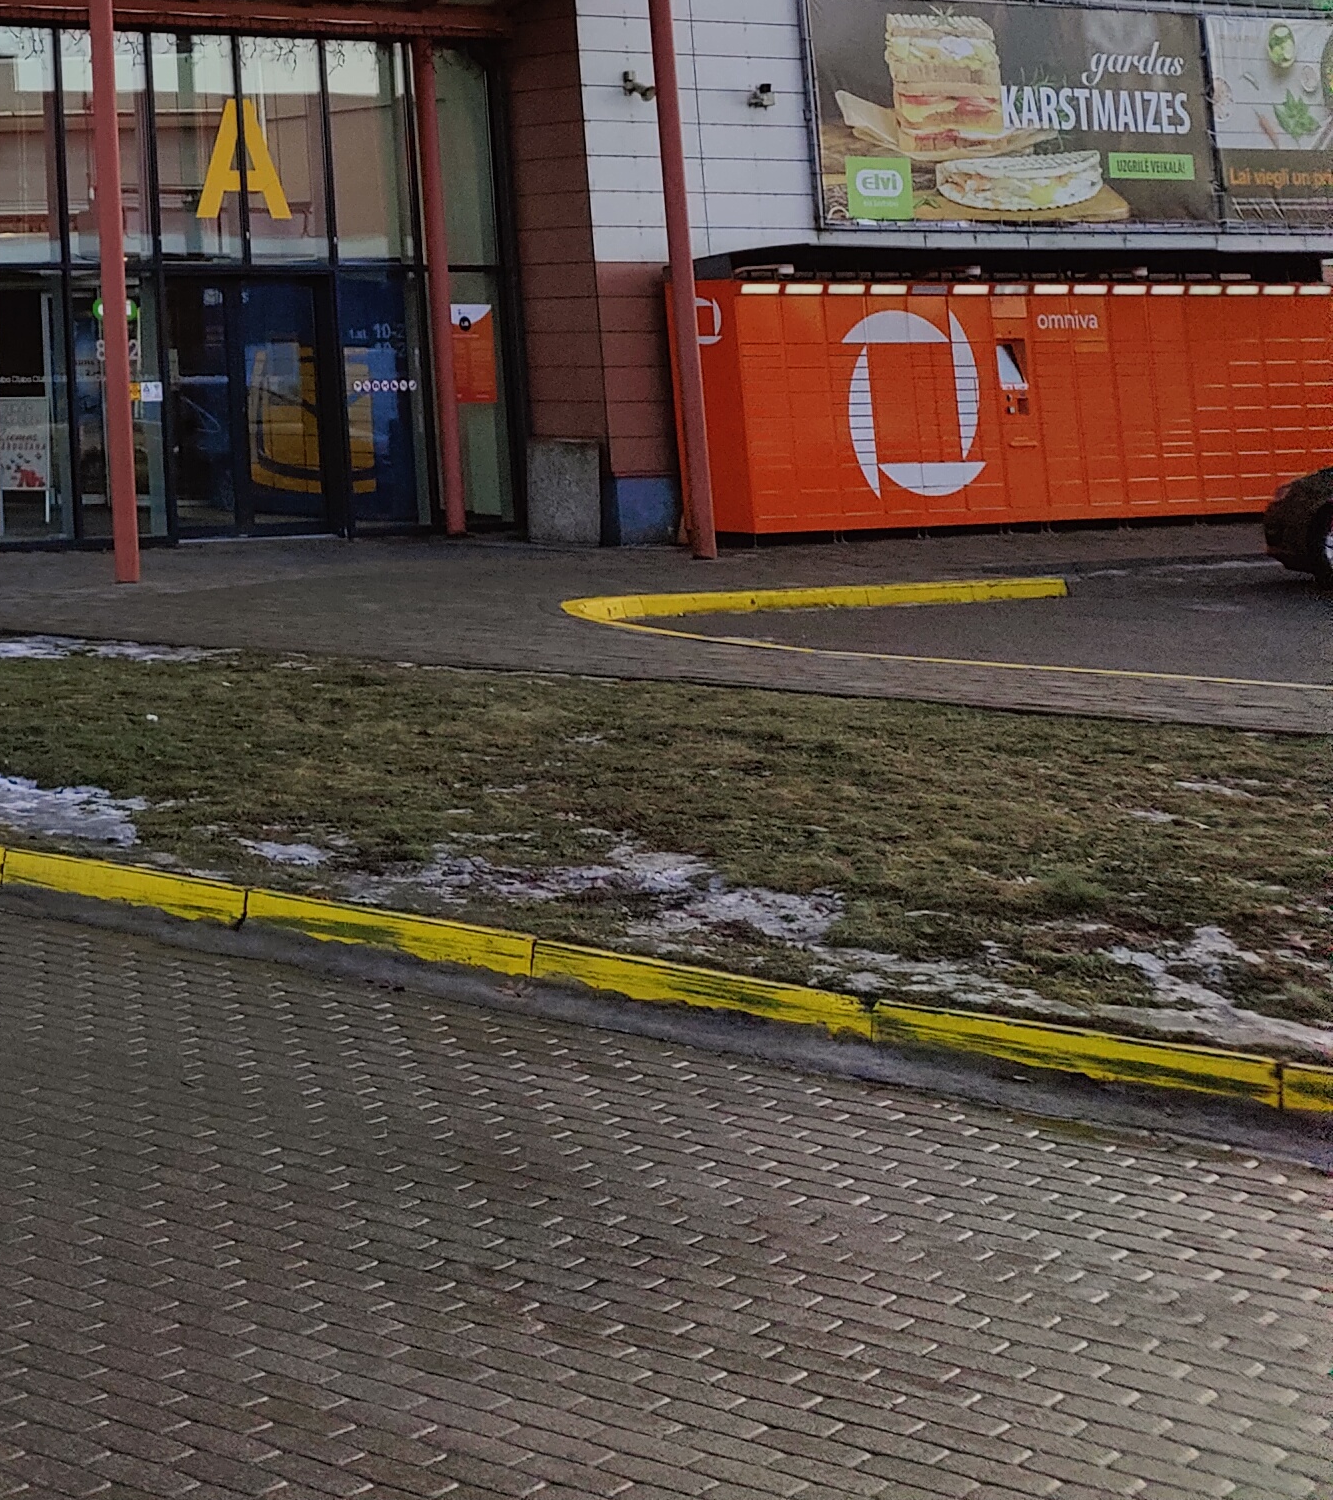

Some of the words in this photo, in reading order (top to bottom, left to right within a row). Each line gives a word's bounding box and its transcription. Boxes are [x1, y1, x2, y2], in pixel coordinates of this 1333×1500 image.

[1083, 41, 1184, 86] gardas
[1001, 85, 1191, 134] KARSTMAIZES
[196, 99, 292, 219] A
[1037, 311, 1099, 330] omniva
